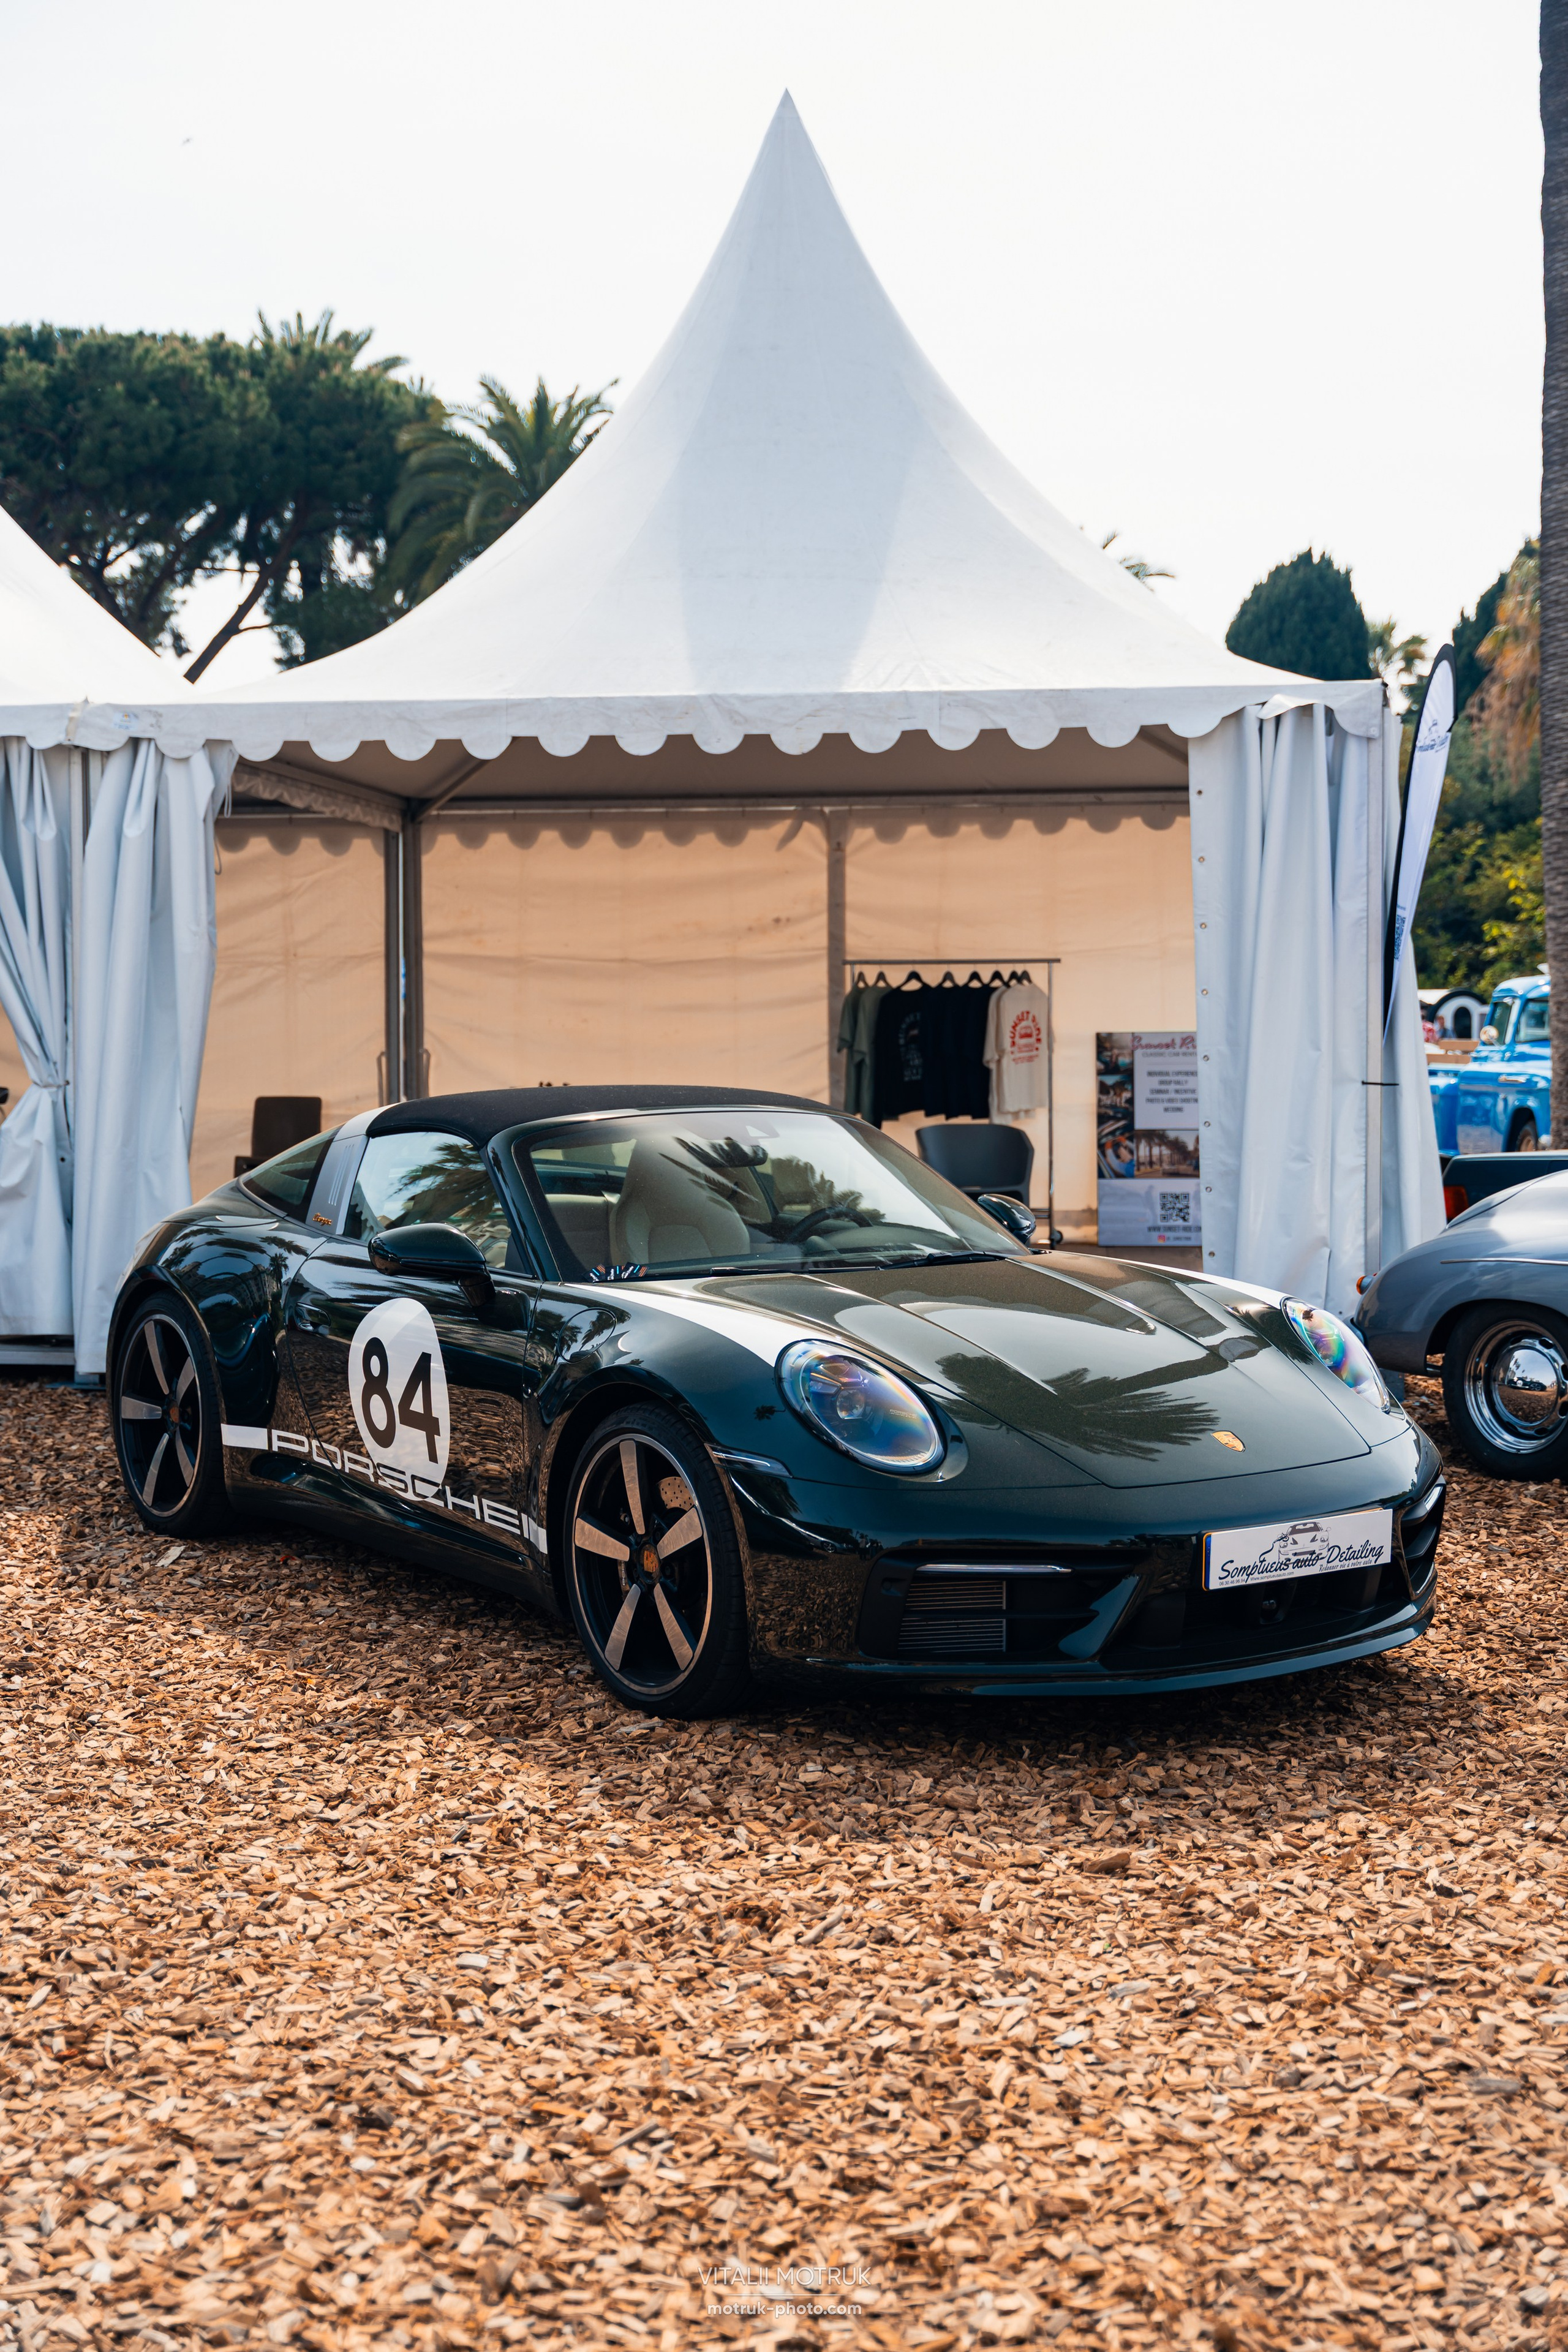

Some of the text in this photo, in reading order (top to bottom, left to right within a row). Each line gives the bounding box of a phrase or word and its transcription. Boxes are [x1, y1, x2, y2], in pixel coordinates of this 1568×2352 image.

[1009, 1011, 1030, 1048] SUNSET
[361, 1336, 441, 1464] 84
[271, 1428, 521, 1535] PORSCHE
[1319, 1563, 1339, 1572] Redonner
